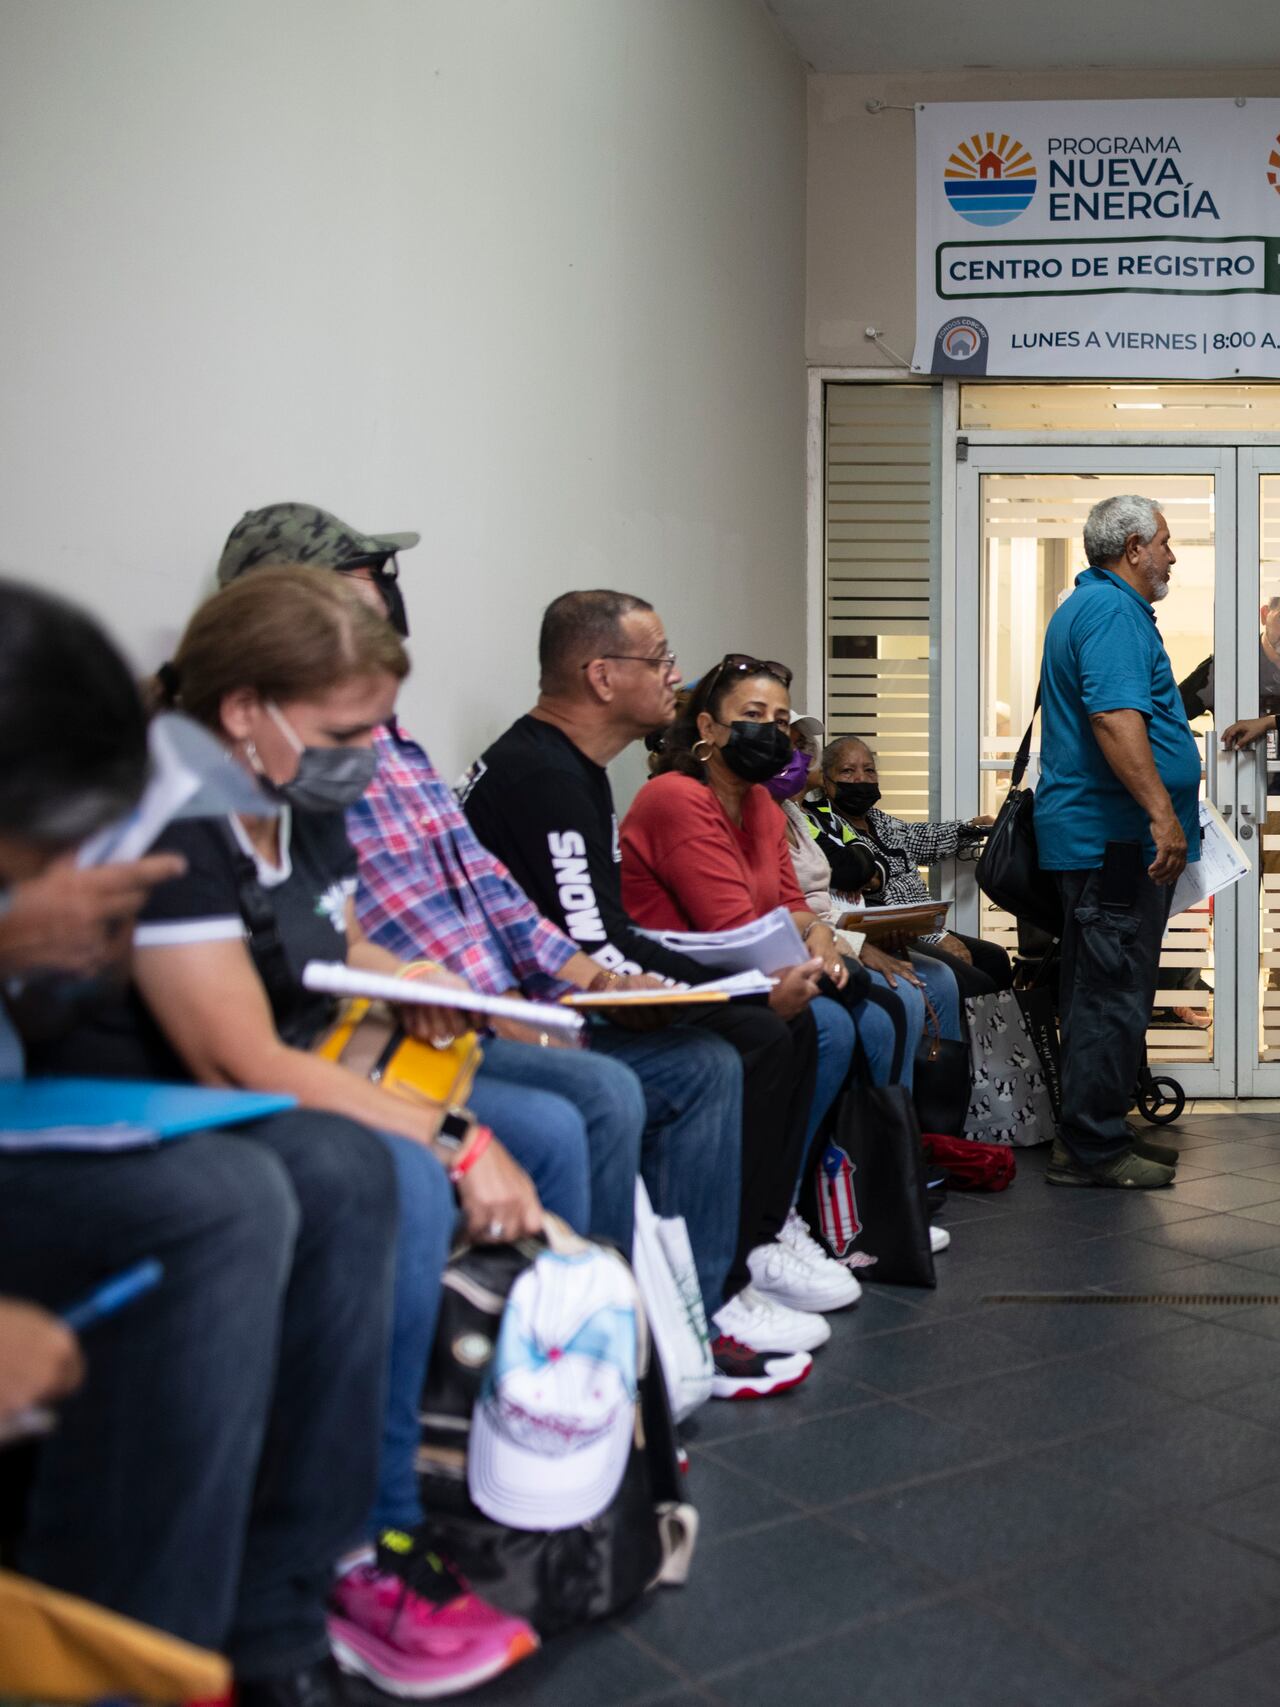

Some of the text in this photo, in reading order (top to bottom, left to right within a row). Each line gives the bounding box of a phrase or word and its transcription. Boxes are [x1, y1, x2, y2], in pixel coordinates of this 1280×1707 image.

[1048, 136, 1181, 155] PROGRAMA
[1050, 158, 1184, 188] NUEVA
[1049, 182, 1220, 221] ENERGÍA
[949, 255, 1255, 281] CENTRO DE REGISTRO
[1011, 331, 1080, 349] LUNES
[1085, 331, 1101, 348] A
[1105, 331, 1197, 350] VIERNES
[1213, 331, 1256, 350] 8:00
[547, 830, 607, 941] SNOW
